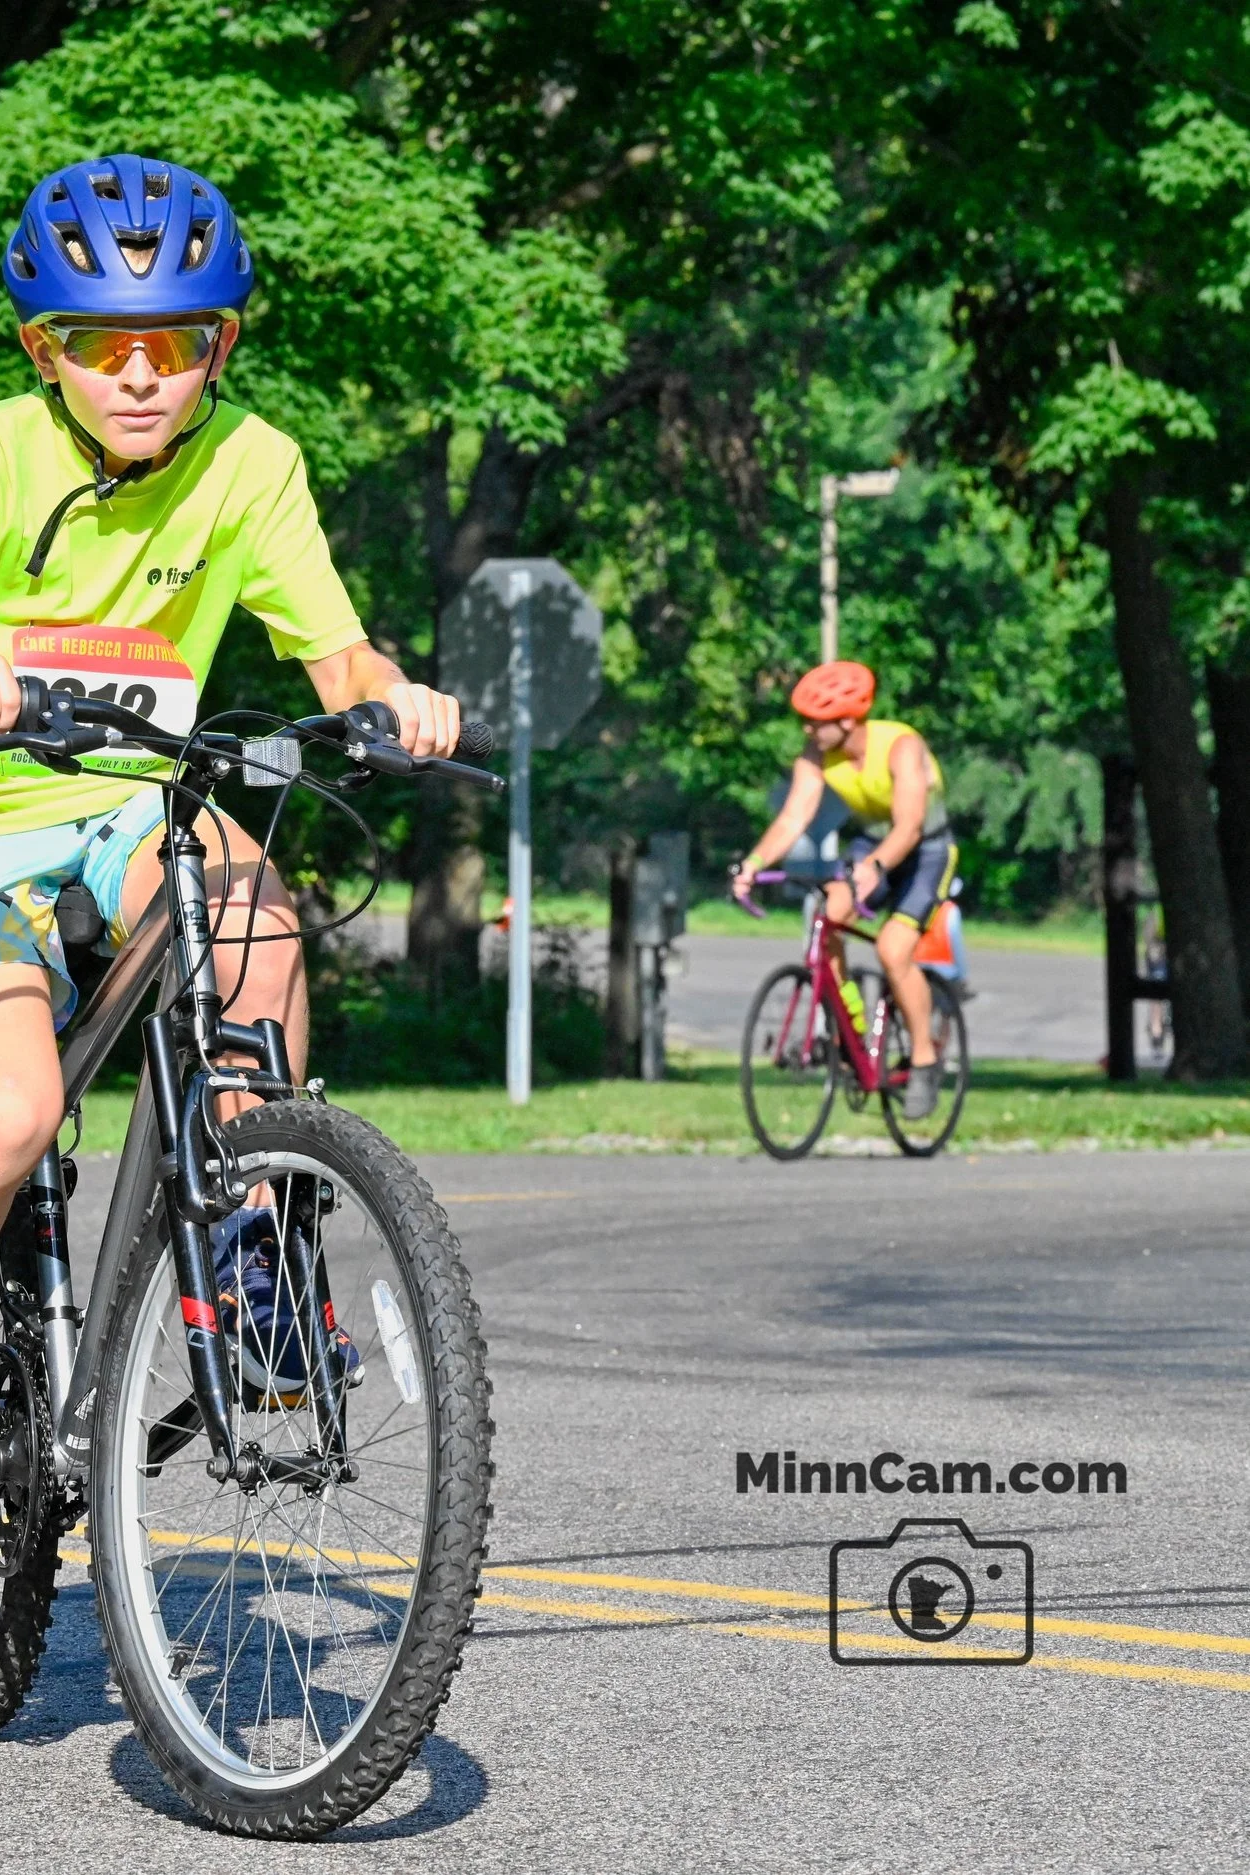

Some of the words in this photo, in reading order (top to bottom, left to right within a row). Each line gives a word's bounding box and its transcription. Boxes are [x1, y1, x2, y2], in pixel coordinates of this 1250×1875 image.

[20, 636, 56, 652] LAKE
[61, 638, 122, 658] REBECCA
[97, 759, 119, 769] JULY
